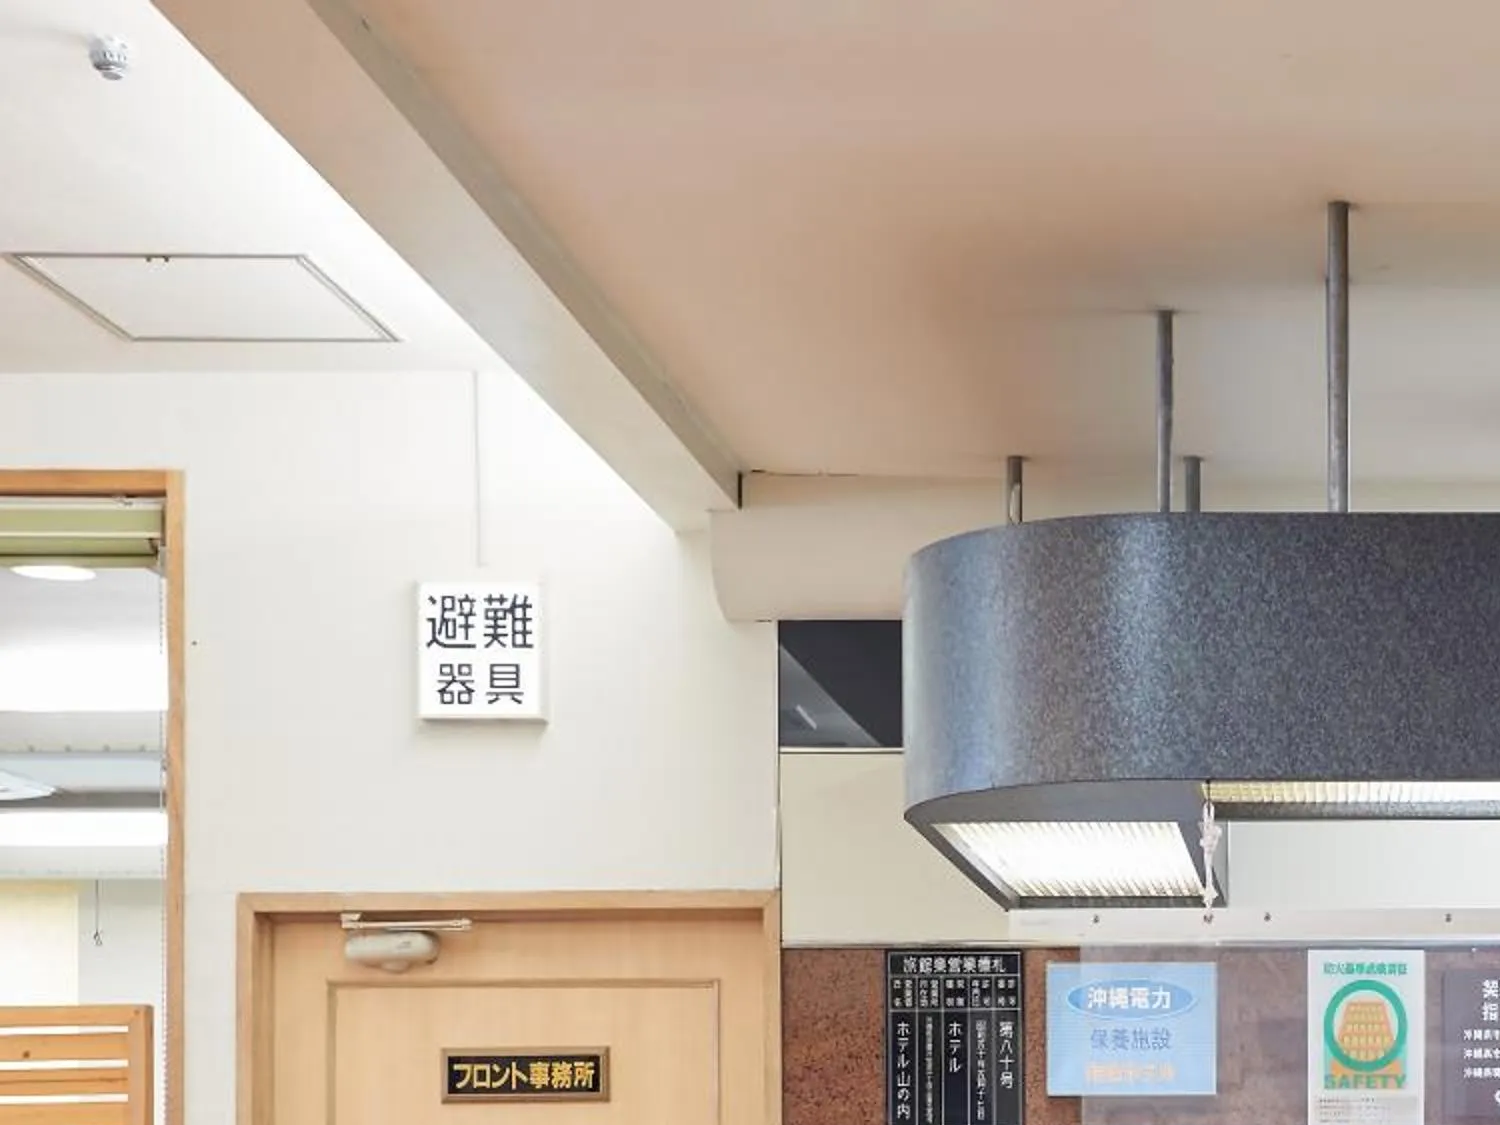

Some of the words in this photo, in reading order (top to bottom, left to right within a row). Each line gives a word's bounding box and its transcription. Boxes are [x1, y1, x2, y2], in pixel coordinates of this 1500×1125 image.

[426, 593, 535, 649] 避難
[436, 663, 525, 705] 器具
[1087, 986, 1171, 1009] 沖縄電力
[949, 1021, 963, 1073] ホテル
[453, 1061, 595, 1090] フロント事務所
[897, 1021, 911, 1121] ホテル山の内
[1324, 1074, 1407, 1090] SAFETY
